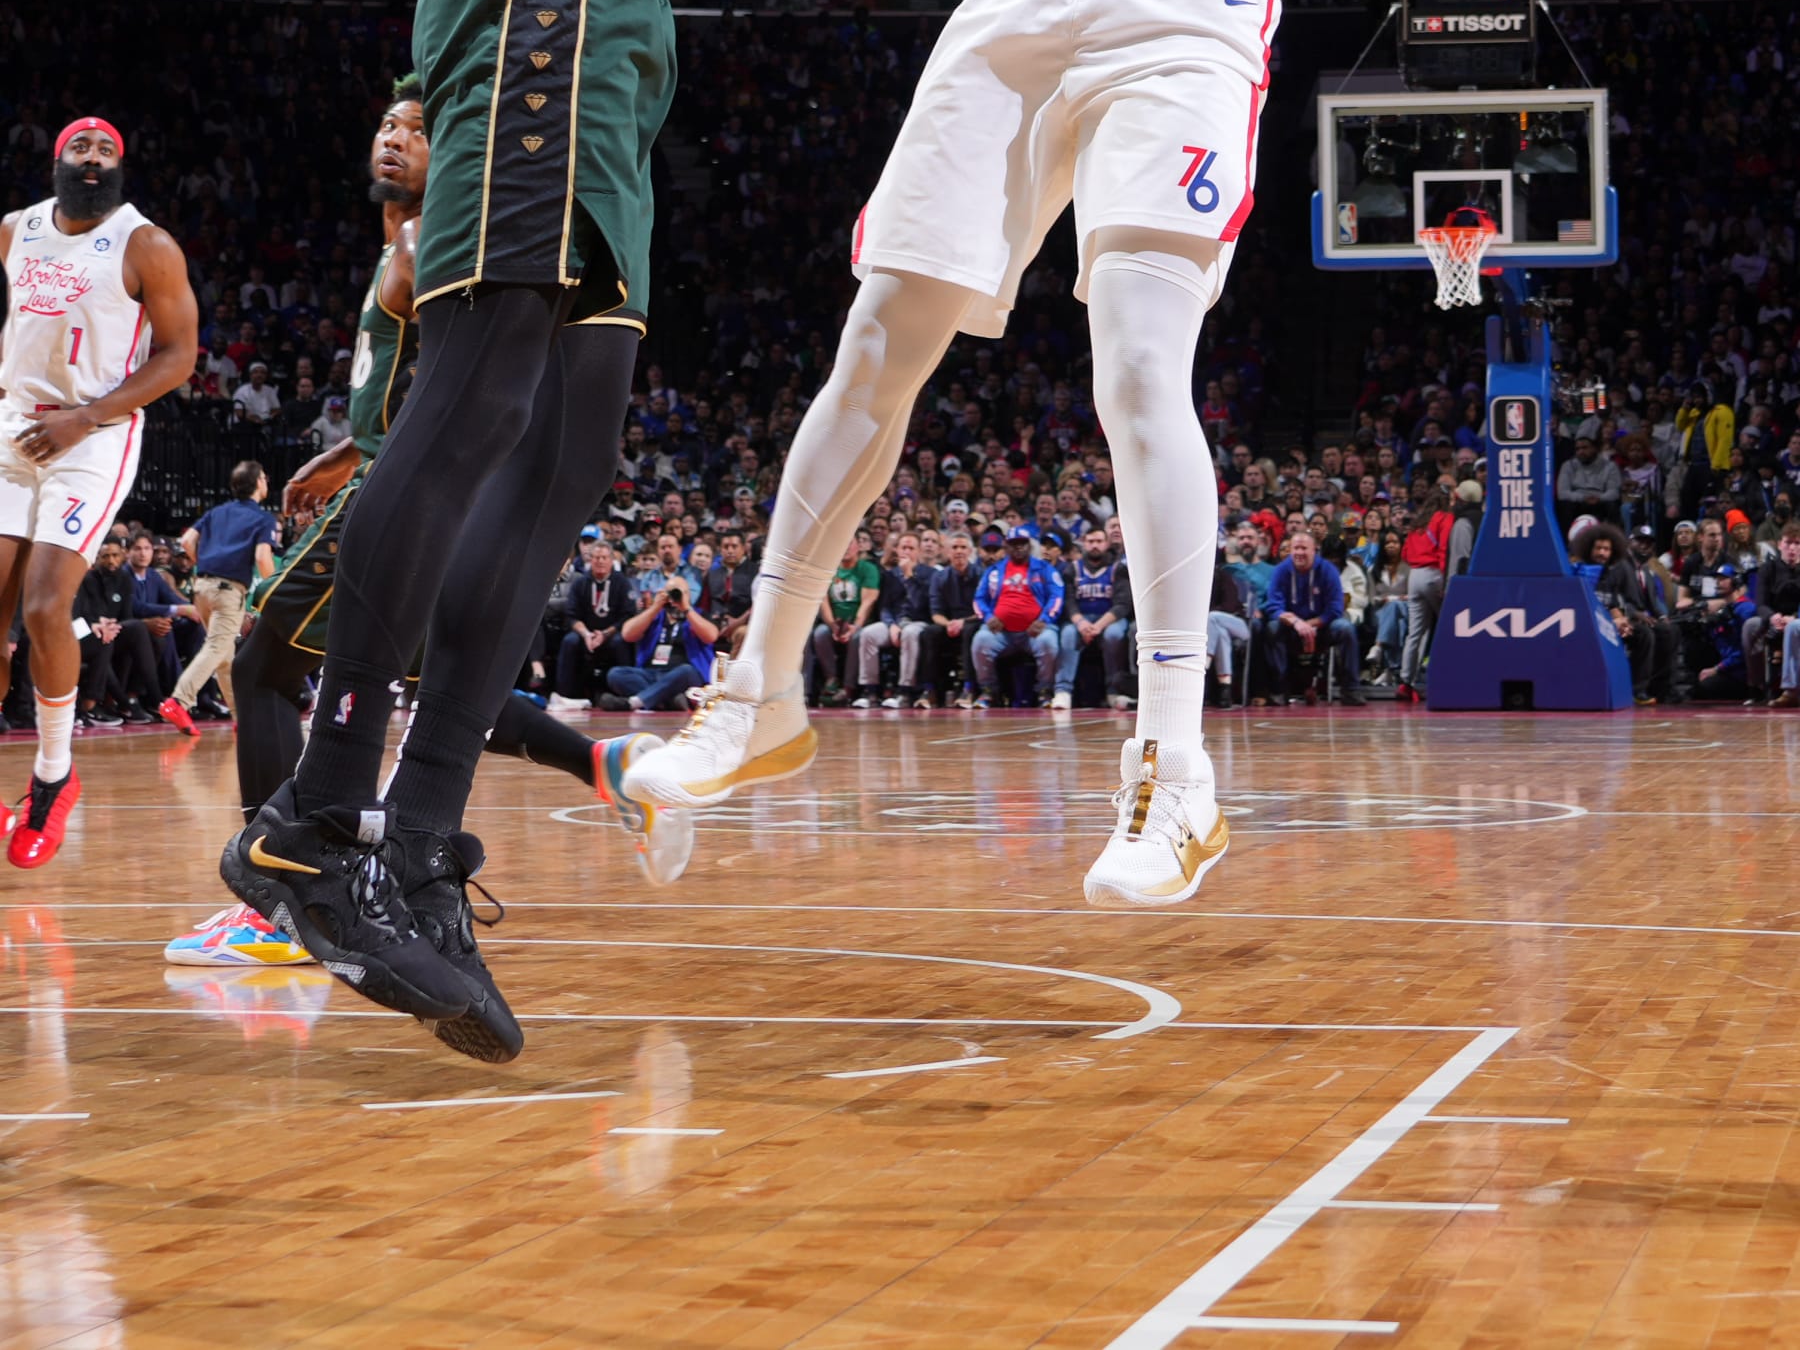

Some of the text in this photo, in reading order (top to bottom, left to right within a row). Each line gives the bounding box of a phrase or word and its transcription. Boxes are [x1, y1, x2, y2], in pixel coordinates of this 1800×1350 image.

[1442, 13, 1526, 32] TISSOT
[1178, 146, 1220, 213] 76
[14, 258, 93, 303] Brotherly
[19, 284, 67, 317] Love
[68, 327, 84, 365] 1
[1498, 448, 1533, 478] GET
[1498, 479, 1534, 508] THE
[60, 496, 84, 535] 76
[1498, 509, 1535, 538] APP
